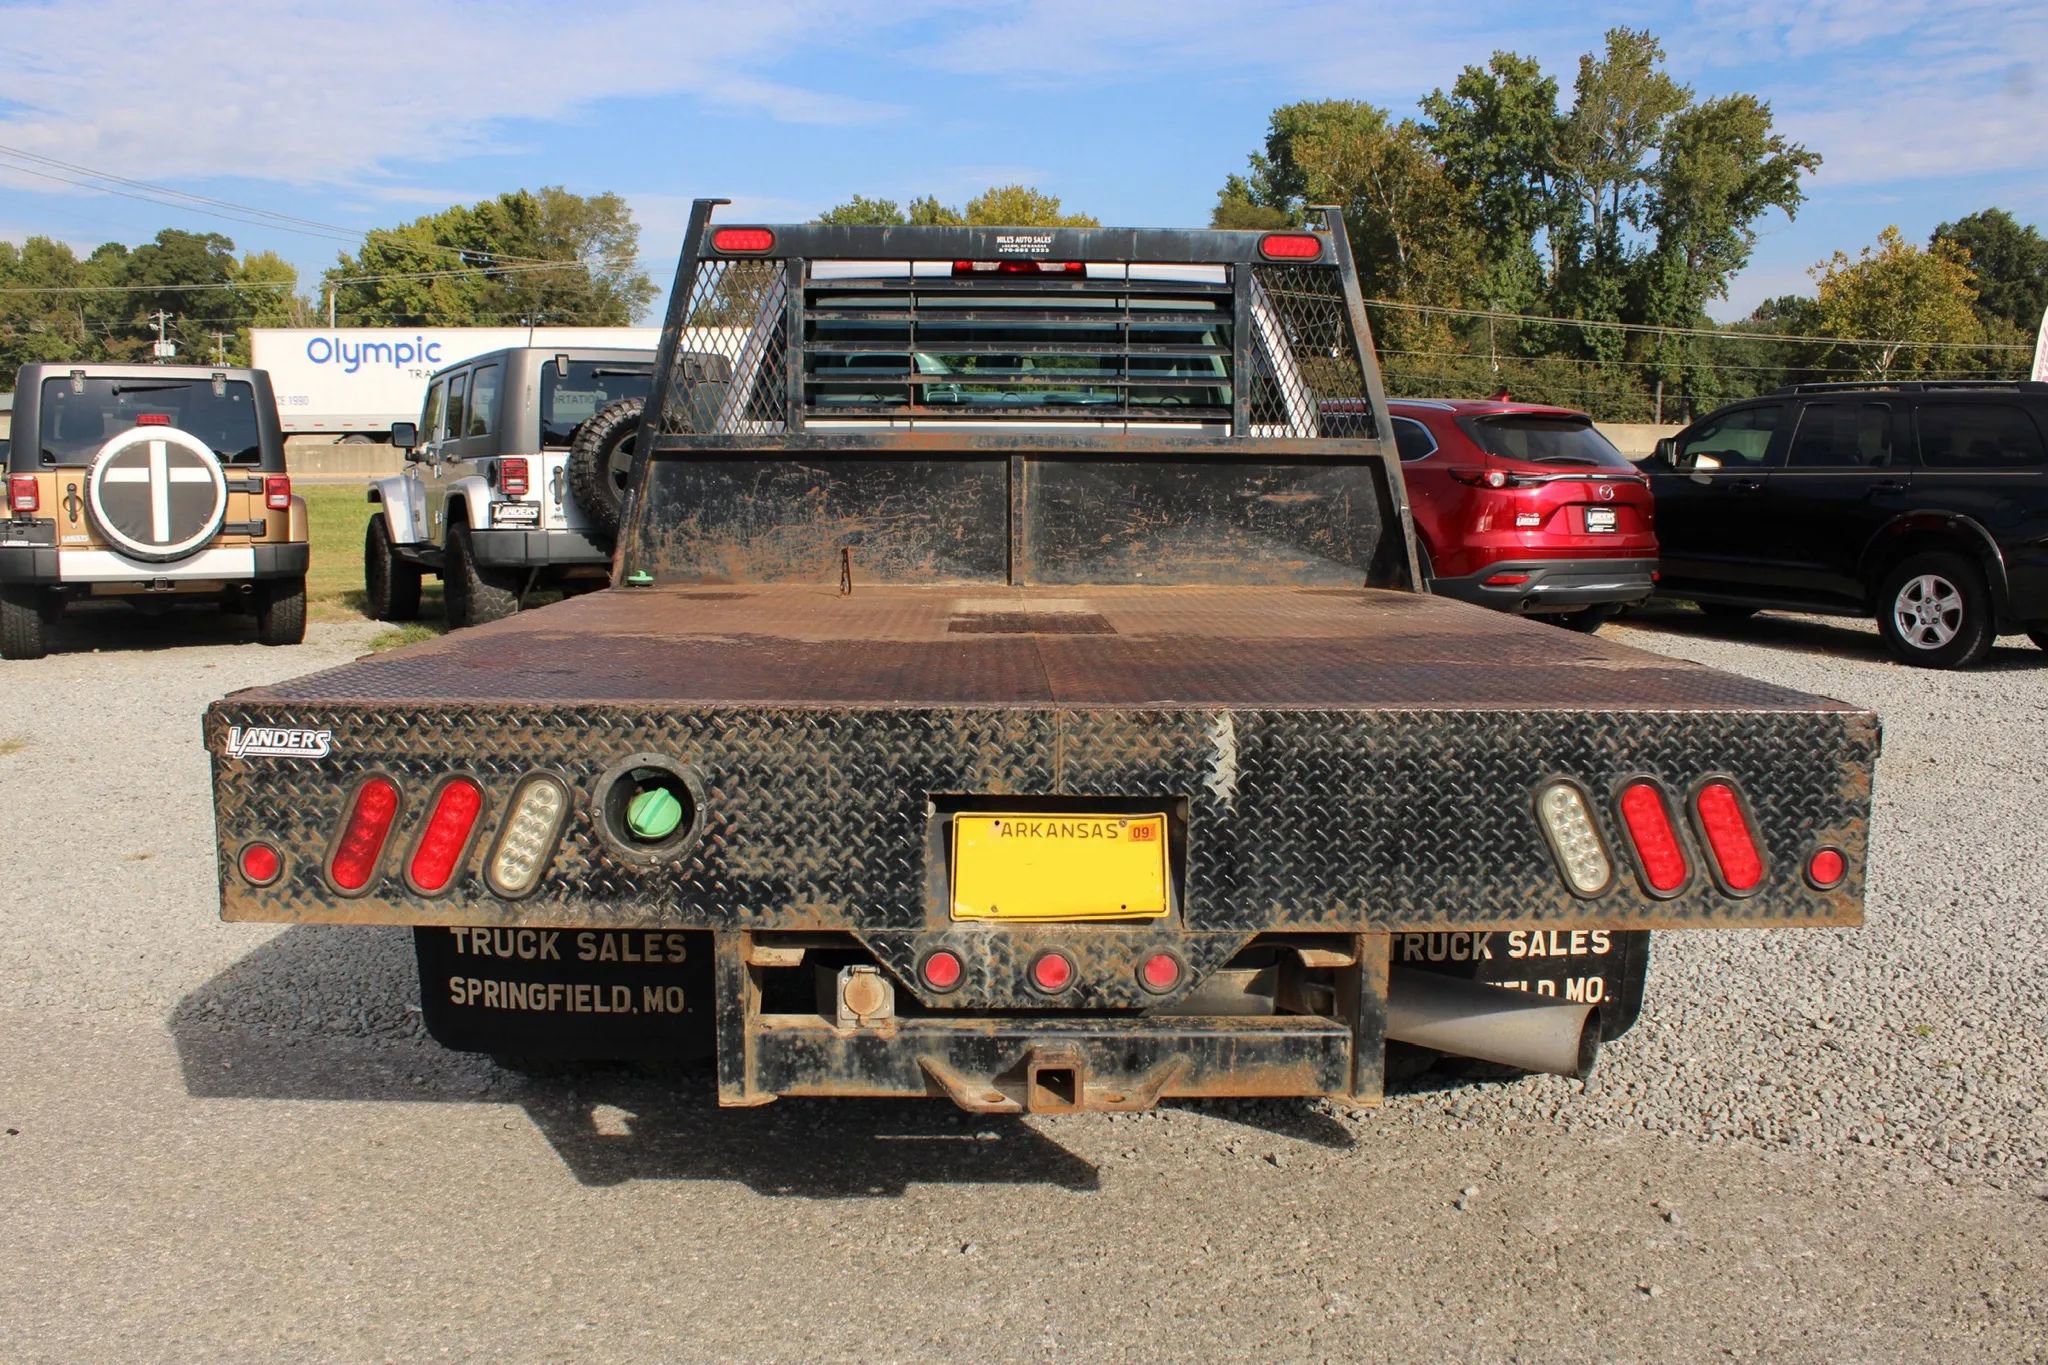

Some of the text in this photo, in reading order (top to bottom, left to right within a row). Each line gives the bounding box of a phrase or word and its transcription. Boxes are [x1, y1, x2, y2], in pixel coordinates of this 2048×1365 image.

[1015, 236, 1033, 244] AUTO
[1034, 236, 1052, 244] SALES
[307, 336, 441, 373] Olympic
[226, 727, 331, 758] LANDERS
[1001, 822, 1119, 839] ARKANSAS
[1132, 826, 1150, 839] 09
[450, 927, 688, 963] TRUCK SALES
[1508, 929, 1612, 958] SALES
[1566, 976, 1610, 1004] MO.
